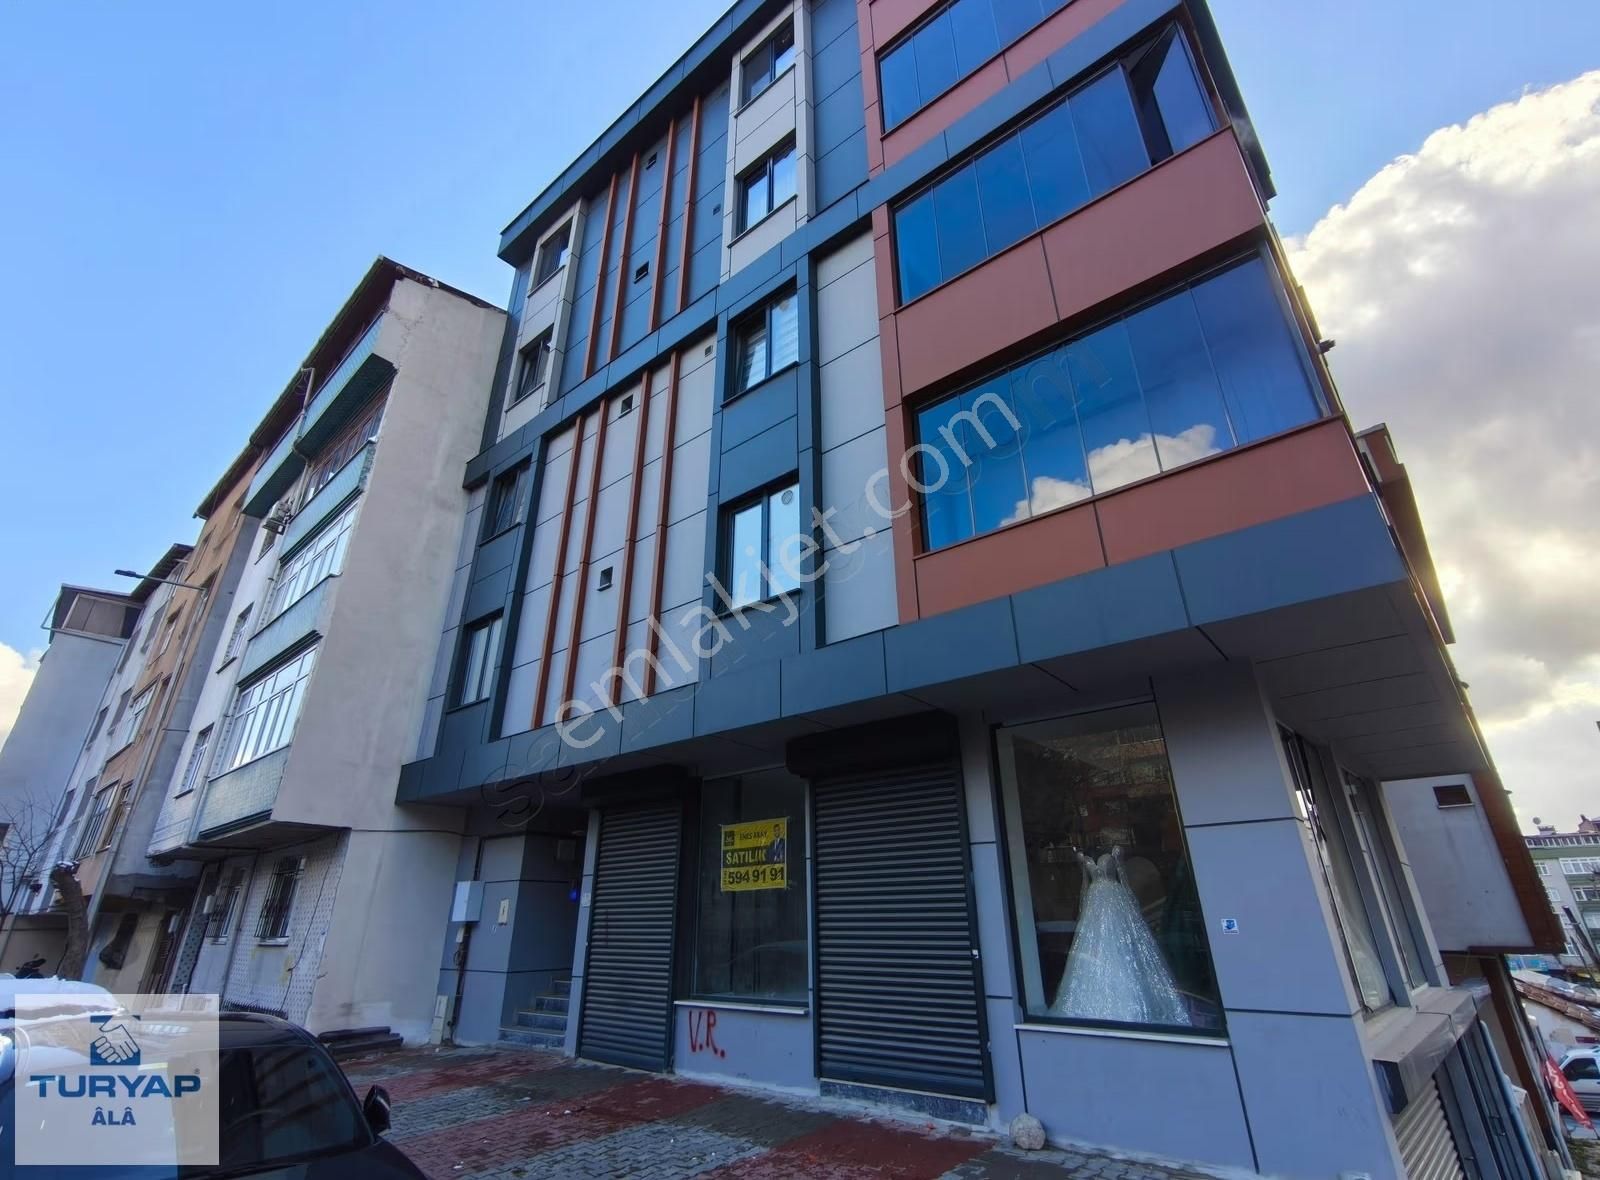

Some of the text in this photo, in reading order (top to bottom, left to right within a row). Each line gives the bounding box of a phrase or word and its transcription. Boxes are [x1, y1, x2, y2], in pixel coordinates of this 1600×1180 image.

[726, 849, 767, 864] SATILIK
[728, 870, 750, 884] 594
[752, 869, 767, 883] 91
[770, 867, 785, 881] 91
